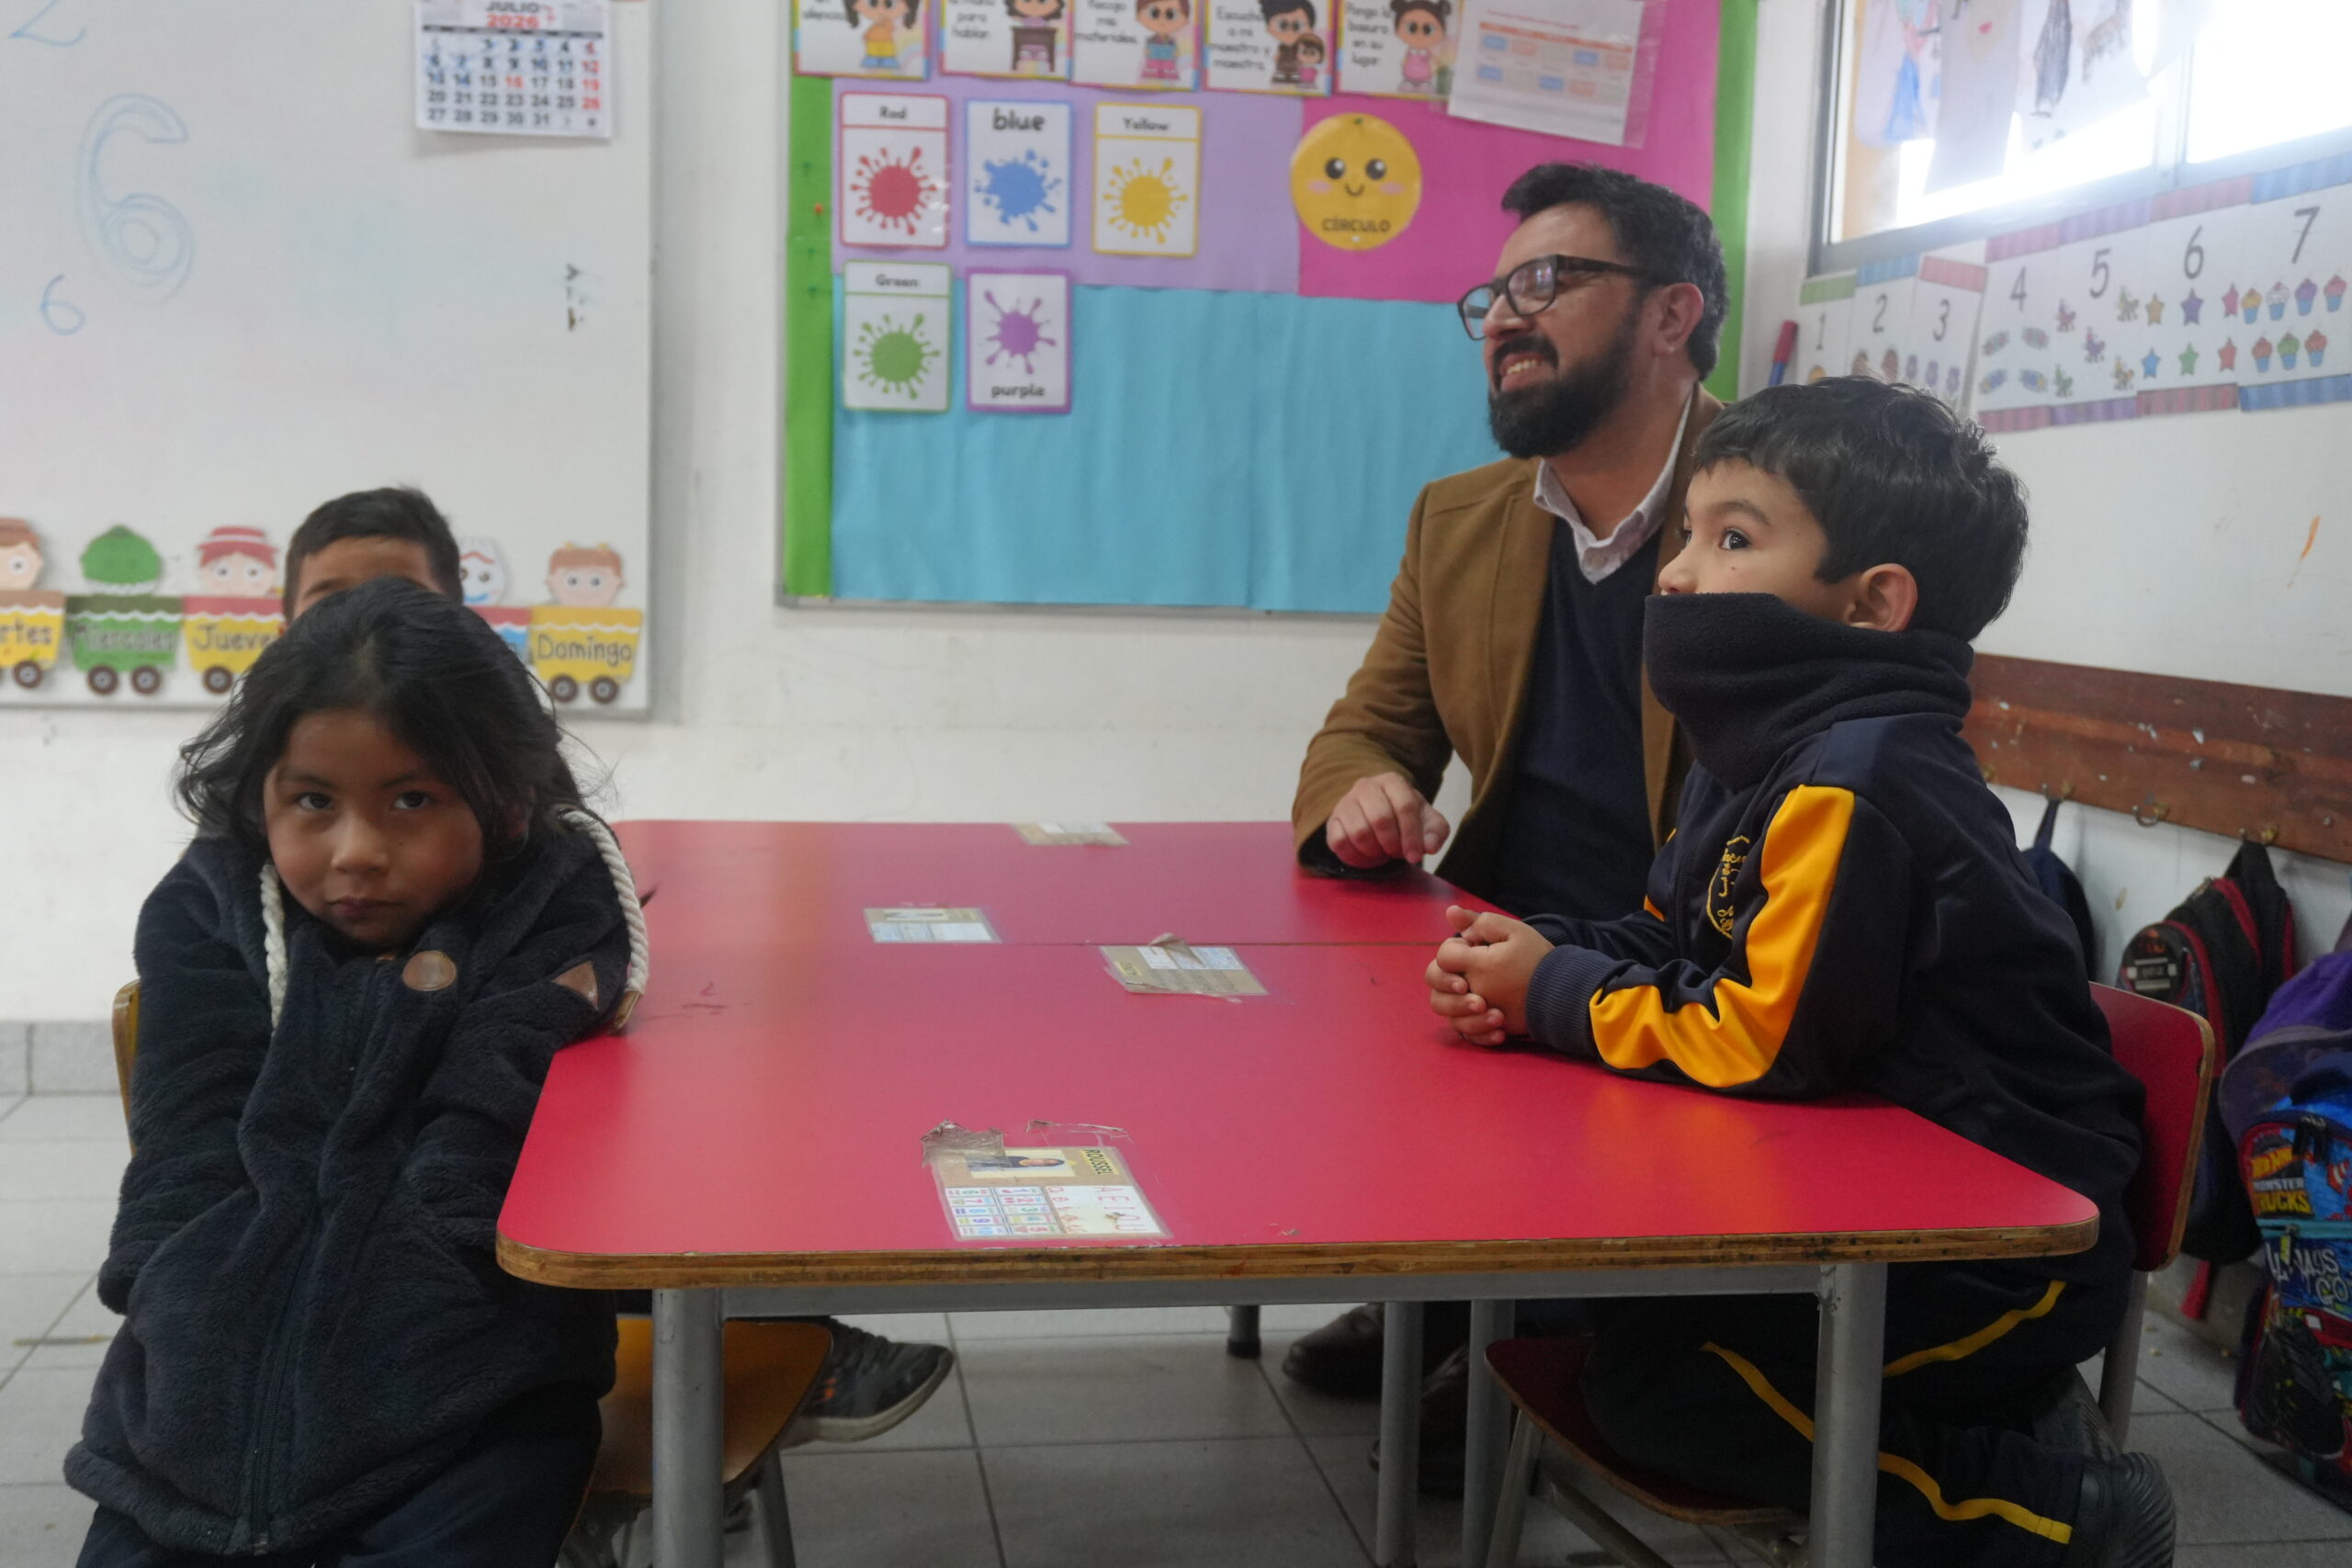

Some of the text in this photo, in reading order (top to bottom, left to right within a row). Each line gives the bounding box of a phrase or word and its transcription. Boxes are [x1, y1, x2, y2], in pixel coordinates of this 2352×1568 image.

[485, 1, 540, 14] JULIO
[480, 74, 497, 87] 15
[506, 75, 524, 89] 16
[532, 76, 548, 88] 17
[557, 77, 575, 90] 18
[427, 90, 601, 110] 20 21 22 23 24 25 26
[879, 106, 908, 121] Red
[428, 107, 549, 125] 27 28 29 30 31
[992, 107, 1046, 131] blue
[1122, 117, 1170, 132] Yellow
[2290, 206, 2322, 264] 7
[2183, 225, 2205, 279] 6
[875, 274, 919, 288] Green
[2089, 249, 2112, 299] 5
[2009, 266, 2028, 312] 4
[40, 274, 85, 335] 6
[1872, 293, 1889, 334] 2
[1815, 312, 1827, 351] 1
[1932, 299, 1951, 342] 3
[991, 382, 1046, 399] purple
[0, 616, 51, 645] rtes
[191, 623, 277, 650] Jueve
[537, 633, 632, 668] Domingo
